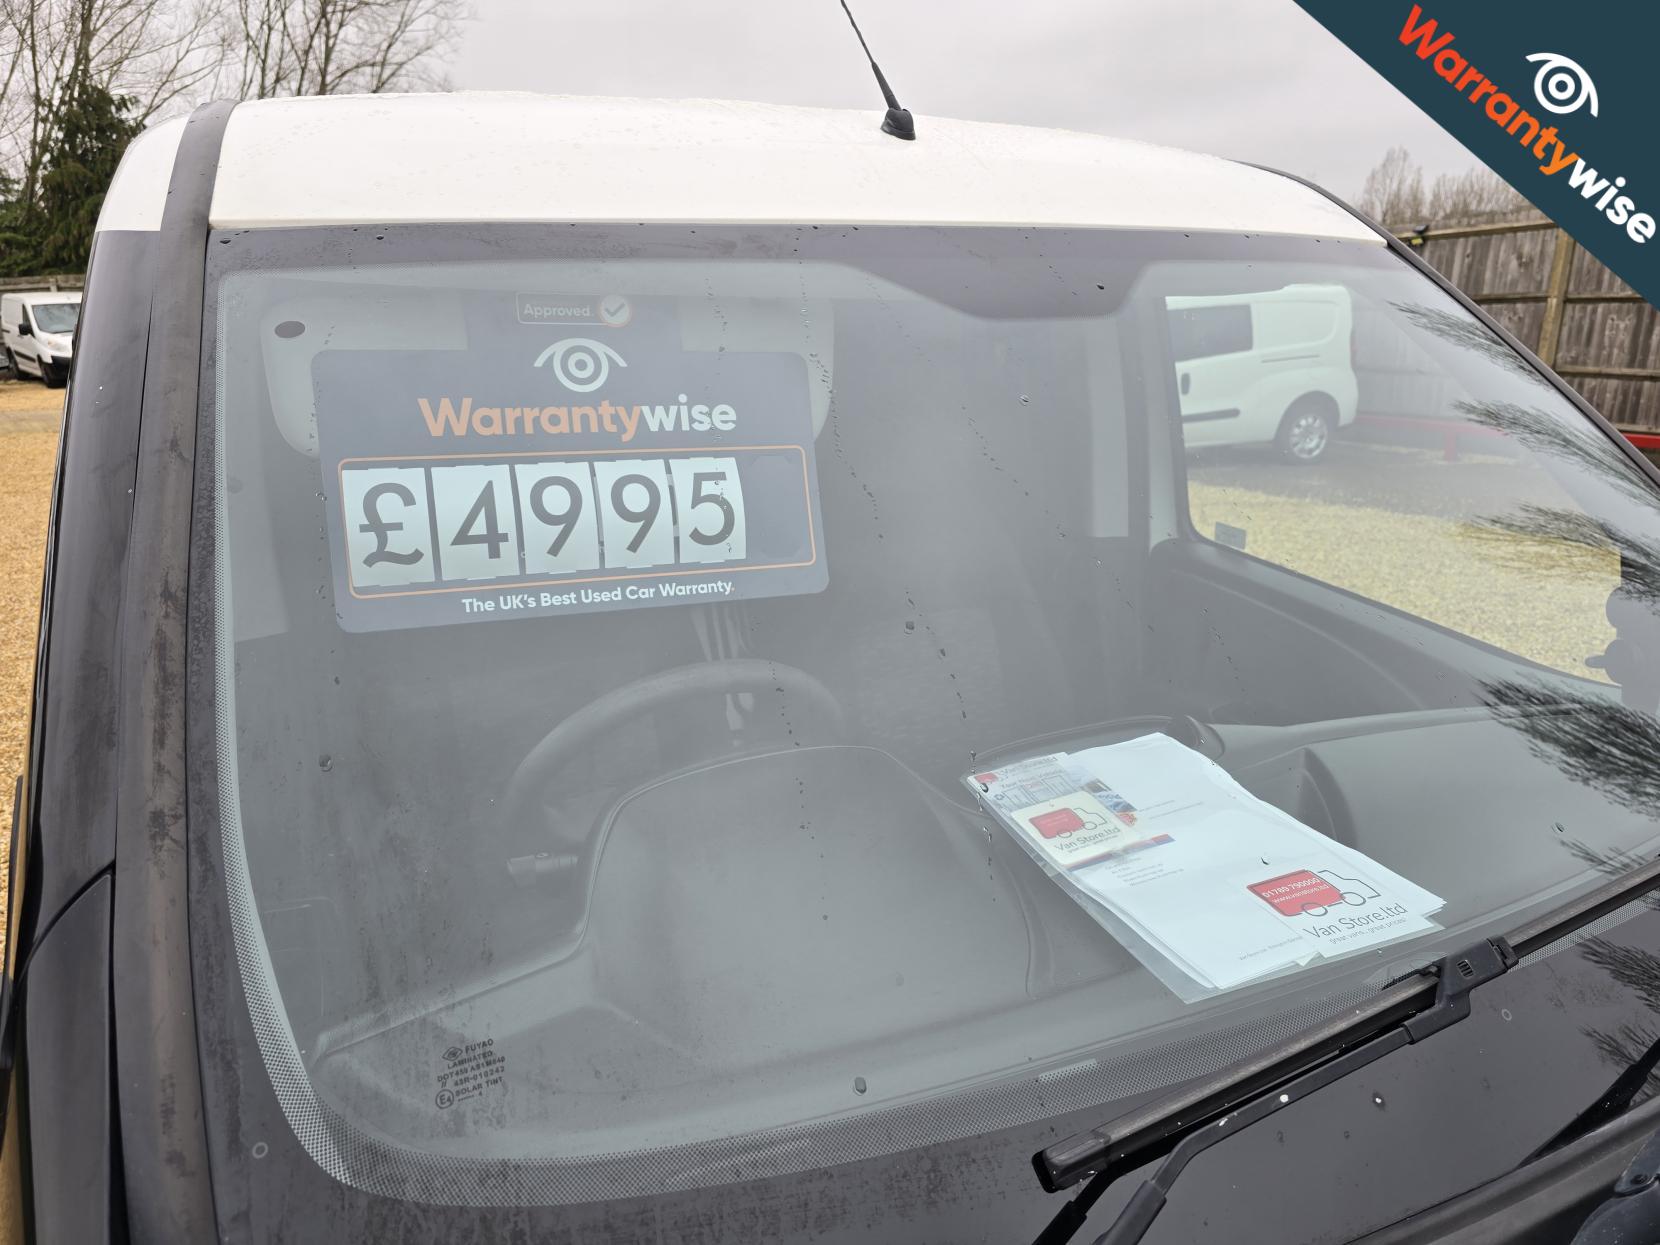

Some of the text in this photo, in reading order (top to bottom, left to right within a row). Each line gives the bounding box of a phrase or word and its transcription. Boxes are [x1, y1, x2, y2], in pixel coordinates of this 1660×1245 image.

[417, 394, 737, 442] Warrantywise
[358, 471, 736, 569] £4995
[462, 597, 495, 614] The
[499, 592, 537, 611] UK's
[540, 590, 577, 608] Best
[580, 586, 622, 604] Used
[626, 585, 656, 601] Car
[1302, 903, 1408, 938] Van Store.ltd
[465, 1038, 494, 1054] FUYAO
[455, 1083, 483, 1097] SOLAR
